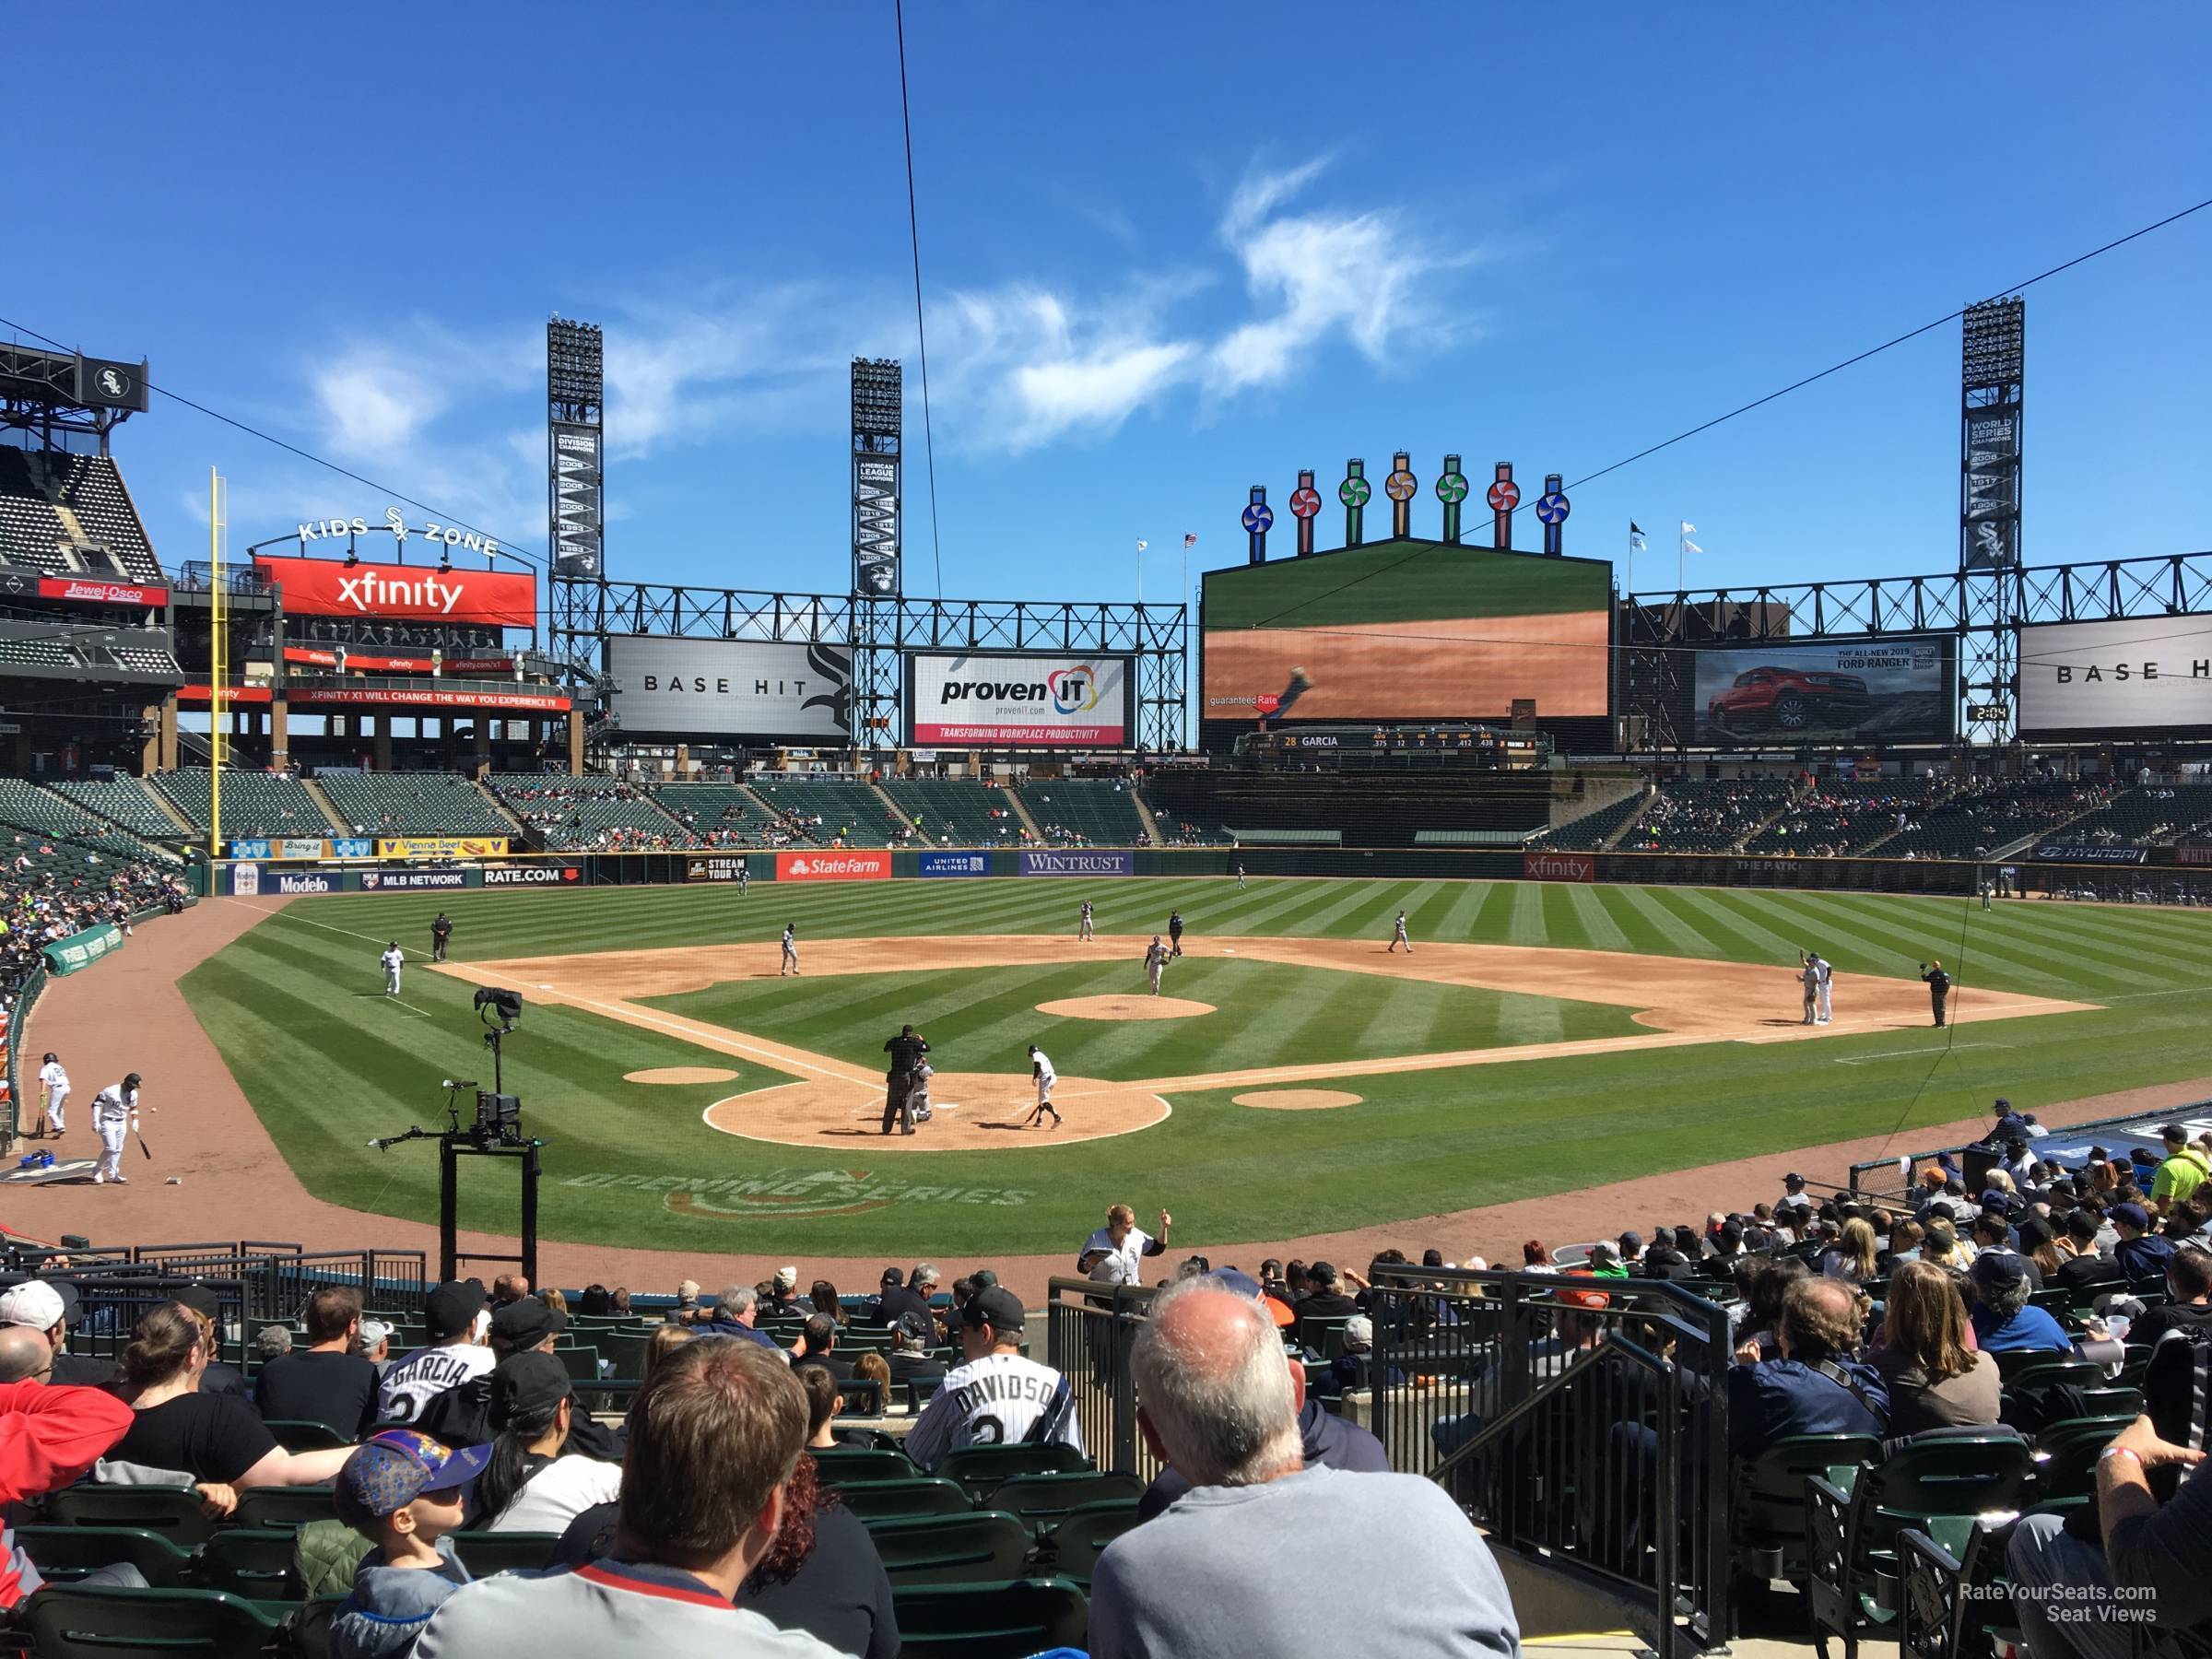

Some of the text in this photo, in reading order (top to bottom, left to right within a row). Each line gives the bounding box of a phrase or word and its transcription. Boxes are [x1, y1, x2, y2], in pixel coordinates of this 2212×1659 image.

[1972, 418, 2012, 429] WORLD
[1972, 427, 2011, 439] SERIES
[559, 438, 594, 448] DIVISION
[1971, 436, 2011, 444] CHAMPIONS
[860, 468, 893, 477] LEAGUE
[298, 517, 368, 541] KIDS
[424, 523, 500, 558] ZONE
[65, 582, 144, 601] Jewel-Osco
[336, 571, 464, 614] xfinity
[389, 660, 414, 669] xfinity
[1838, 659, 1865, 668] FORD
[1867, 658, 1910, 667] RANGER
[2057, 663, 2158, 683] BASE
[644, 675, 806, 696] BASE HIT
[940, 680, 1085, 704] proven IT
[311, 691, 349, 700] XFINITY
[352, 691, 362, 700] X1
[365, 691, 389, 700] WILL
[392, 692, 432, 701] CHANGE
[435, 693, 453, 702] THE
[455, 694, 476, 703] WAY
[478, 695, 497, 704] YOU
[499, 696, 546, 707] EXPERIENCE
[1209, 695, 1277, 707] guaranteed Rate
[995, 705, 1045, 716] provenIT.com
[1977, 708, 2006, 719] 2:04
[940, 727, 1099, 739] TRANSFORMING WORKPLACE PRODUCTIVITY
[1285, 737, 1297, 746] 28
[1301, 737, 1337, 746] GARCIA
[285, 841, 320, 851] Bring it
[402, 840, 460, 848] Vienna Beef
[2065, 848, 2137, 859] HYUNDAI
[708, 859, 745, 869] STREAM
[1528, 855, 1589, 878] xfinity
[1736, 860, 1760, 870] THE
[485, 869, 559, 883] RATE.COM
[708, 869, 732, 878] YOUR
[280, 877, 328, 893] Modelo
[383, 874, 462, 886] MLB NETWORK
[394, 1357, 469, 1386] GARCIA
